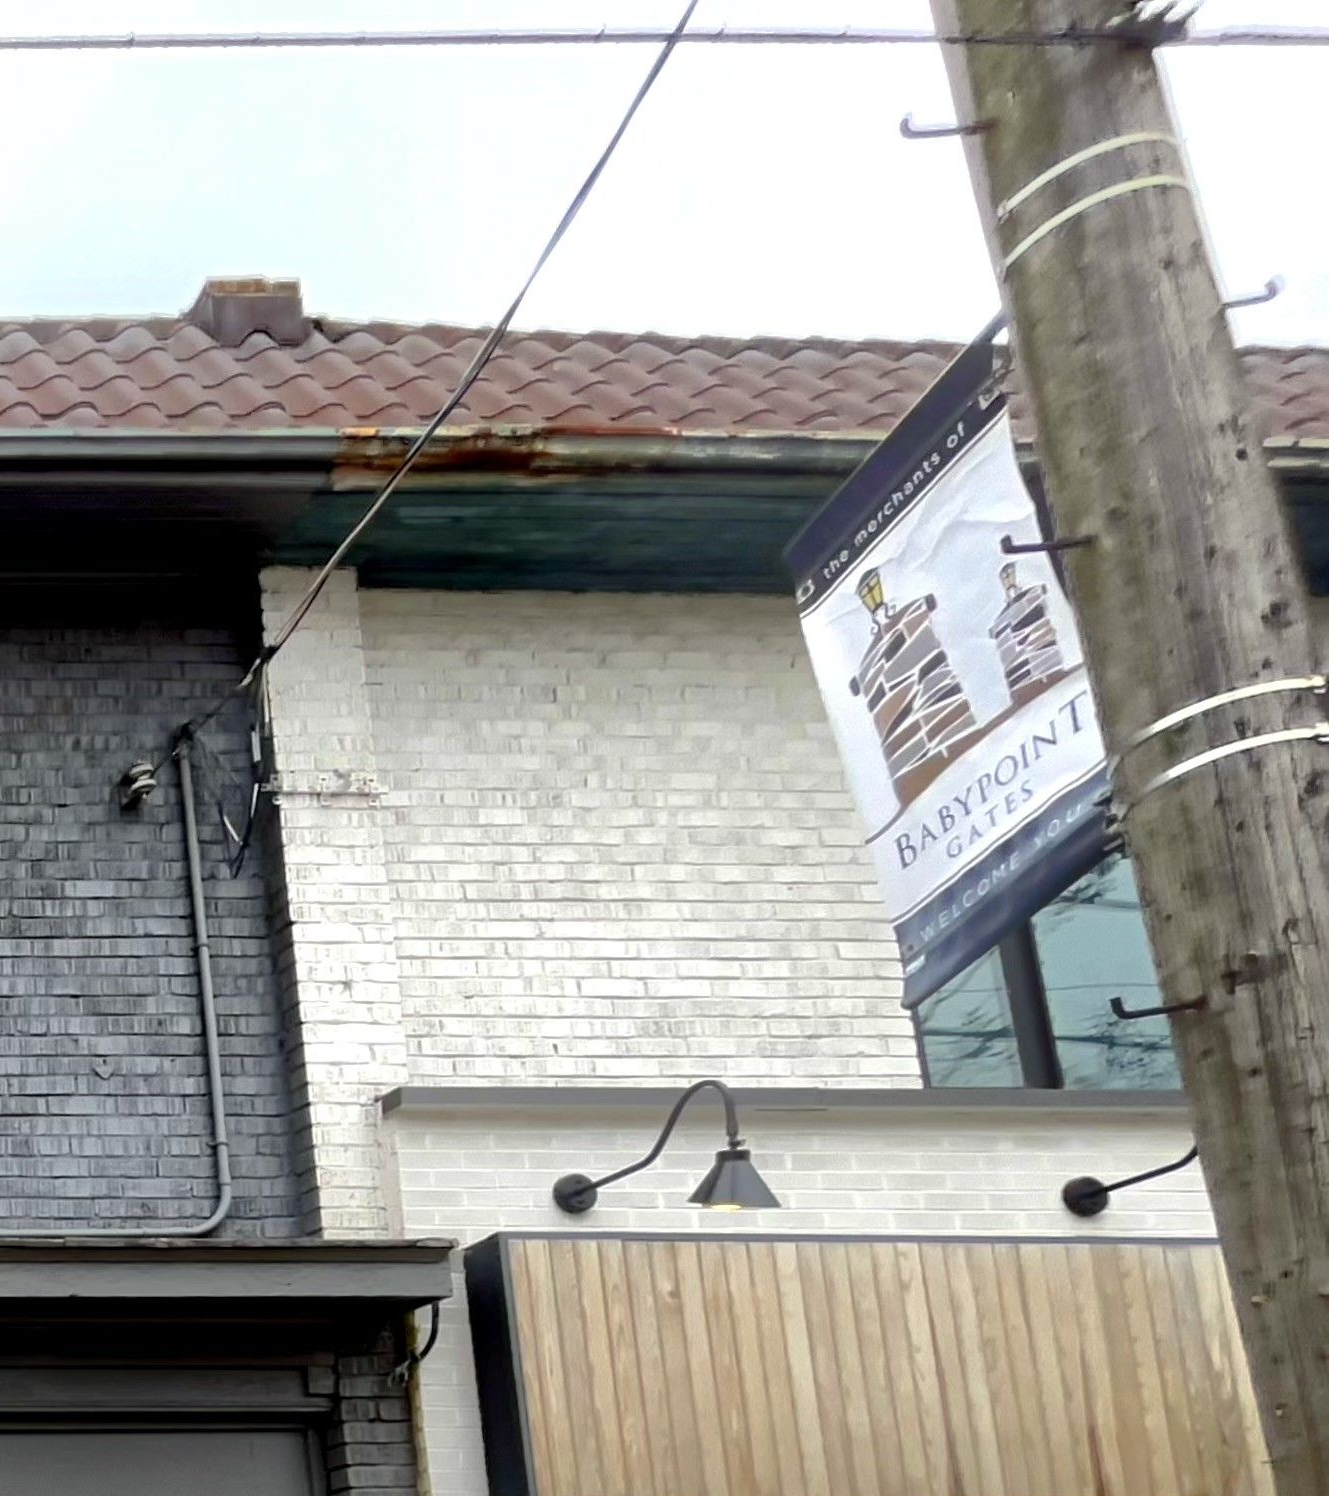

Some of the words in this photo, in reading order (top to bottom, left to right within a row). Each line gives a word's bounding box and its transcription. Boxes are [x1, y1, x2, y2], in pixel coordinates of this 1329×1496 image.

[823, 550, 849, 579] the
[854, 452, 941, 547] merchants
[946, 421, 964, 448] of
[946, 780, 1034, 859] GATES
[920, 851, 1021, 942] WELCOME
